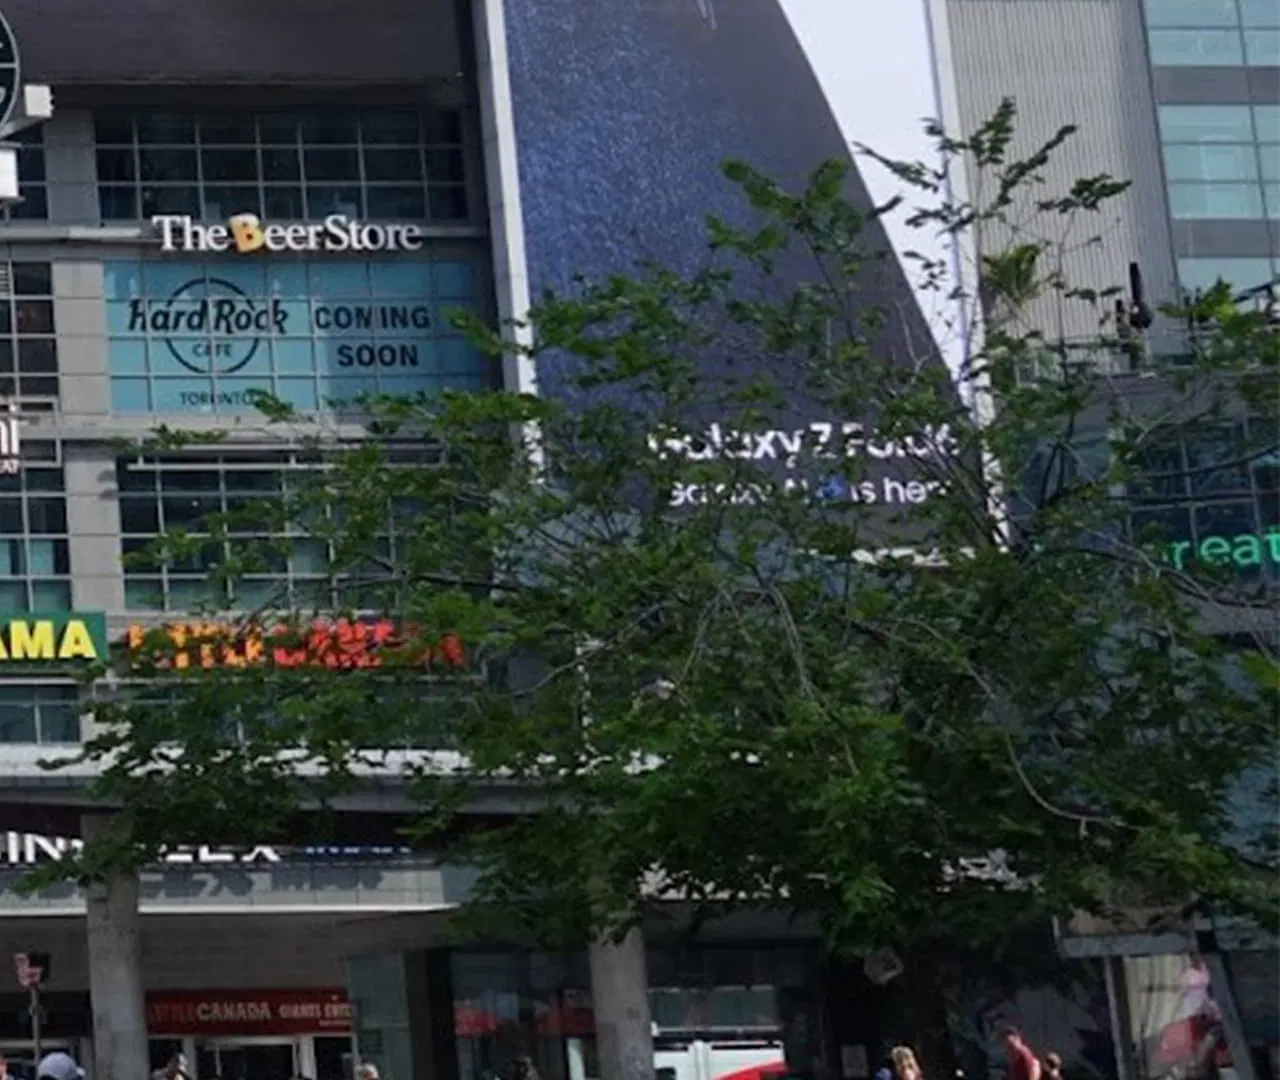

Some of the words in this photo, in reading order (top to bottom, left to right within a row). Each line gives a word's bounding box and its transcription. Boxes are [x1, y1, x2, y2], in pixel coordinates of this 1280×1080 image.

[212, 296, 289, 336] Rock
[314, 304, 432, 332] COMING
[336, 343, 420, 368] SOON
